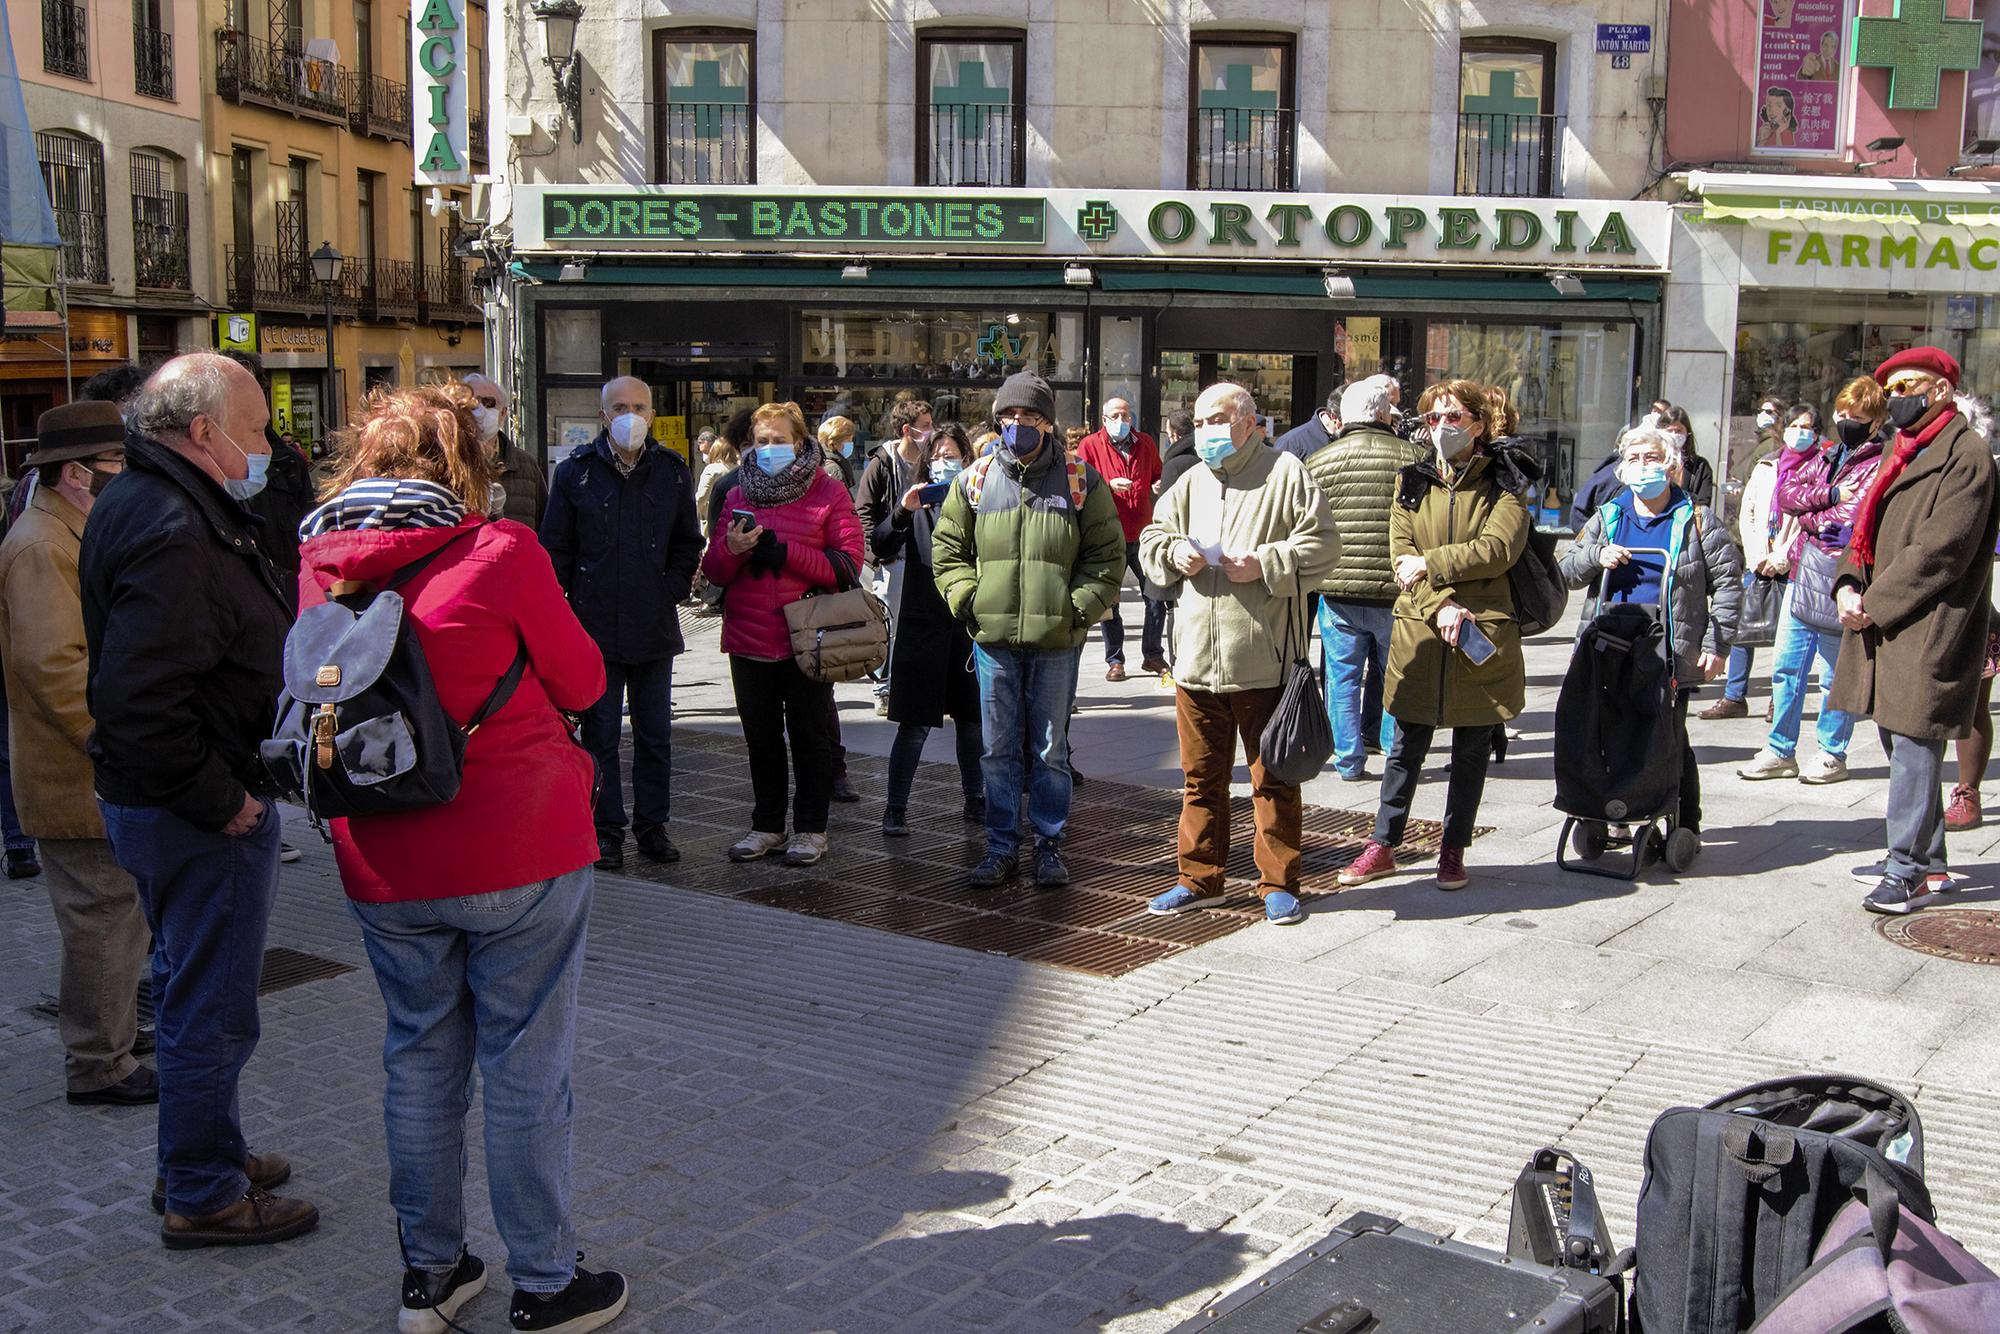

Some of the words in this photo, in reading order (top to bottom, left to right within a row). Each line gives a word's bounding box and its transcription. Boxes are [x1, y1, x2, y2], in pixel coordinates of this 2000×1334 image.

[1608, 26, 1638, 34] PLAZA
[1795, 33, 1810, 41] me
[1801, 42, 1811, 51] in
[1612, 56, 1629, 68] 48
[1763, 62, 1782, 71] and
[1779, 199, 1914, 218] FARMACIA
[1926, 203, 1969, 220] DEL
[752, 201, 1004, 237] BASTONES
[1147, 200, 1637, 255] ORTOPEDIA
[1767, 230, 1999, 271] FARMAC
